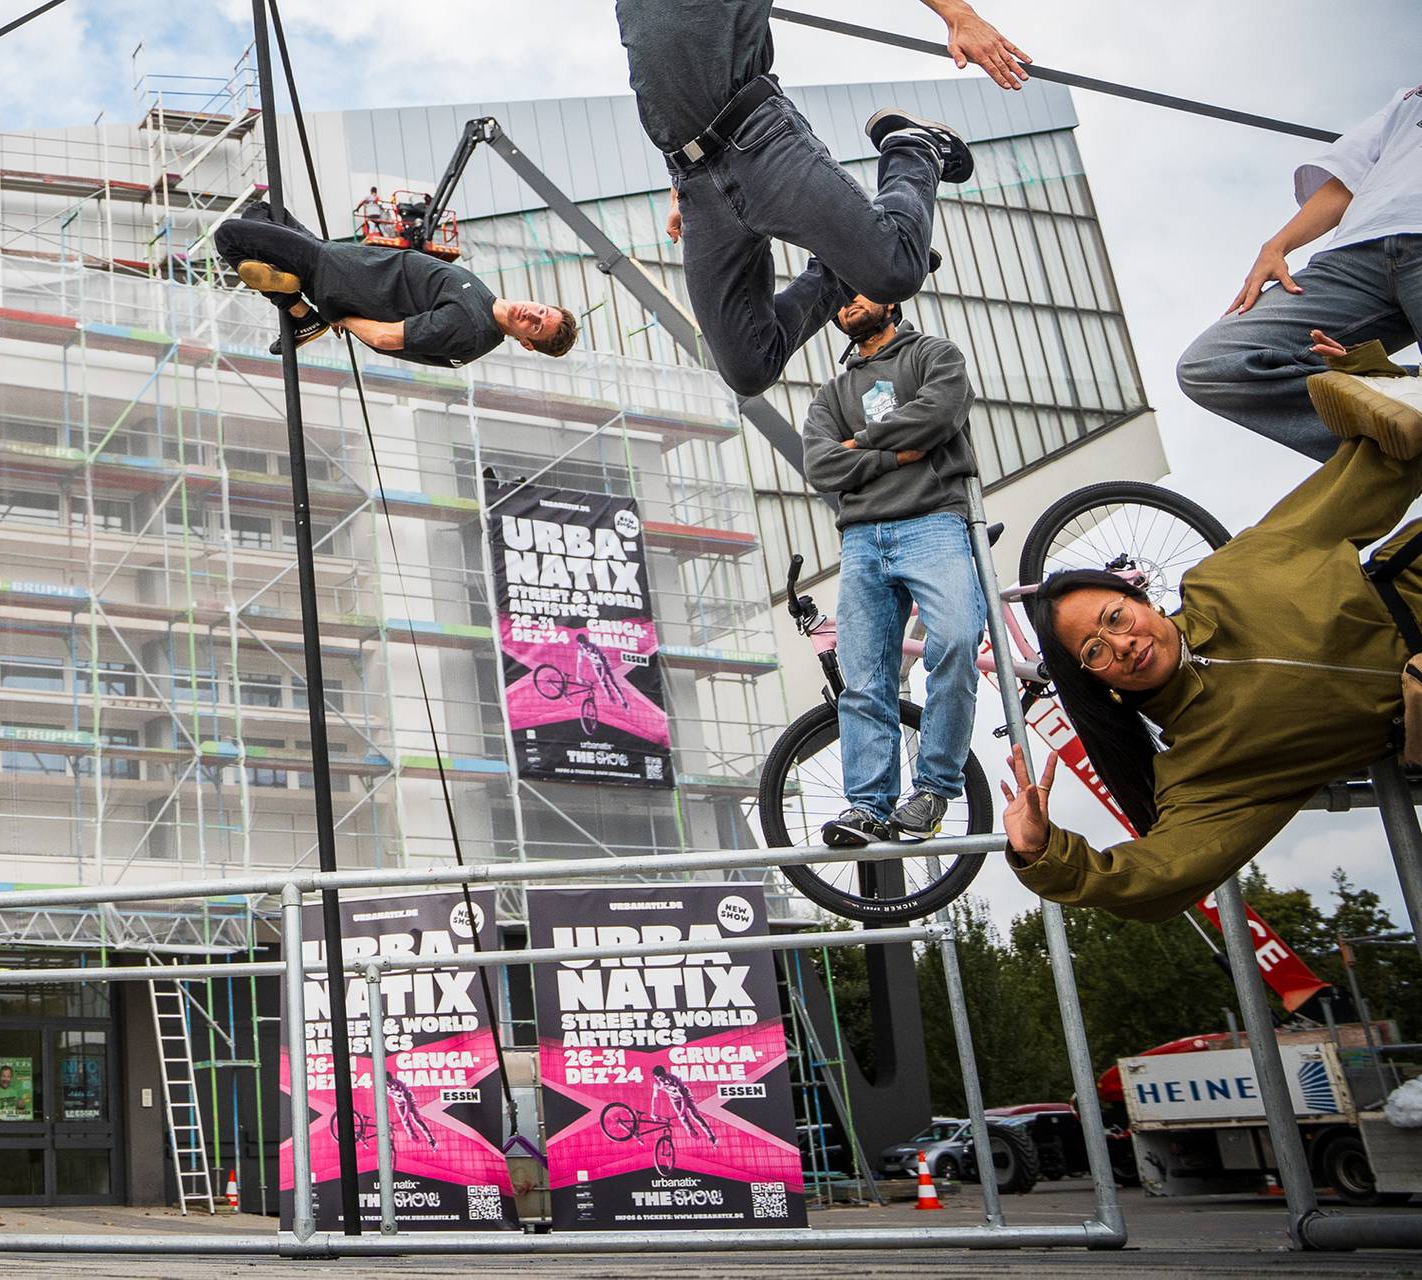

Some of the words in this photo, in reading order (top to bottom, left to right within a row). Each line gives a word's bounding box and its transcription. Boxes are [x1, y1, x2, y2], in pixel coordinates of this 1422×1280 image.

[501, 514, 638, 561] URBA-
[504, 549, 642, 595] NATIX
[508, 584, 570, 603] STREET
[571, 591, 588, 604] &
[588, 591, 643, 610] WORLD
[508, 598, 600, 617] ARTISTICS
[588, 632, 638, 651] HALLE
[622, 653, 648, 665] ESSEN
[567, 750, 596, 764] THE
[610, 901, 684, 912] URBANATIX.DE
[725, 903, 748, 914] NEW
[884, 900, 918, 912] KICKER
[721, 910, 751, 923] SHOW
[557, 965, 756, 1011] NATIX
[383, 1019, 399, 1034] &
[402, 1016, 479, 1033] WORLD
[561, 1012, 648, 1031] STREET
[651, 1012, 671, 1028] &
[673, 1009, 758, 1028] WORLD
[562, 1029, 687, 1048] ARTISTICS
[396, 1052, 480, 1070] GRUGA-
[668, 1045, 763, 1065] GRUGA-
[397, 1069, 467, 1087] HALLE
[670, 1064, 747, 1083] HALLE
[443, 1091, 478, 1101] ESSEN
[720, 1086, 763, 1097] ESSEN
[1136, 1077, 1258, 1104] HEINE
[631, 1191, 673, 1206] THE
